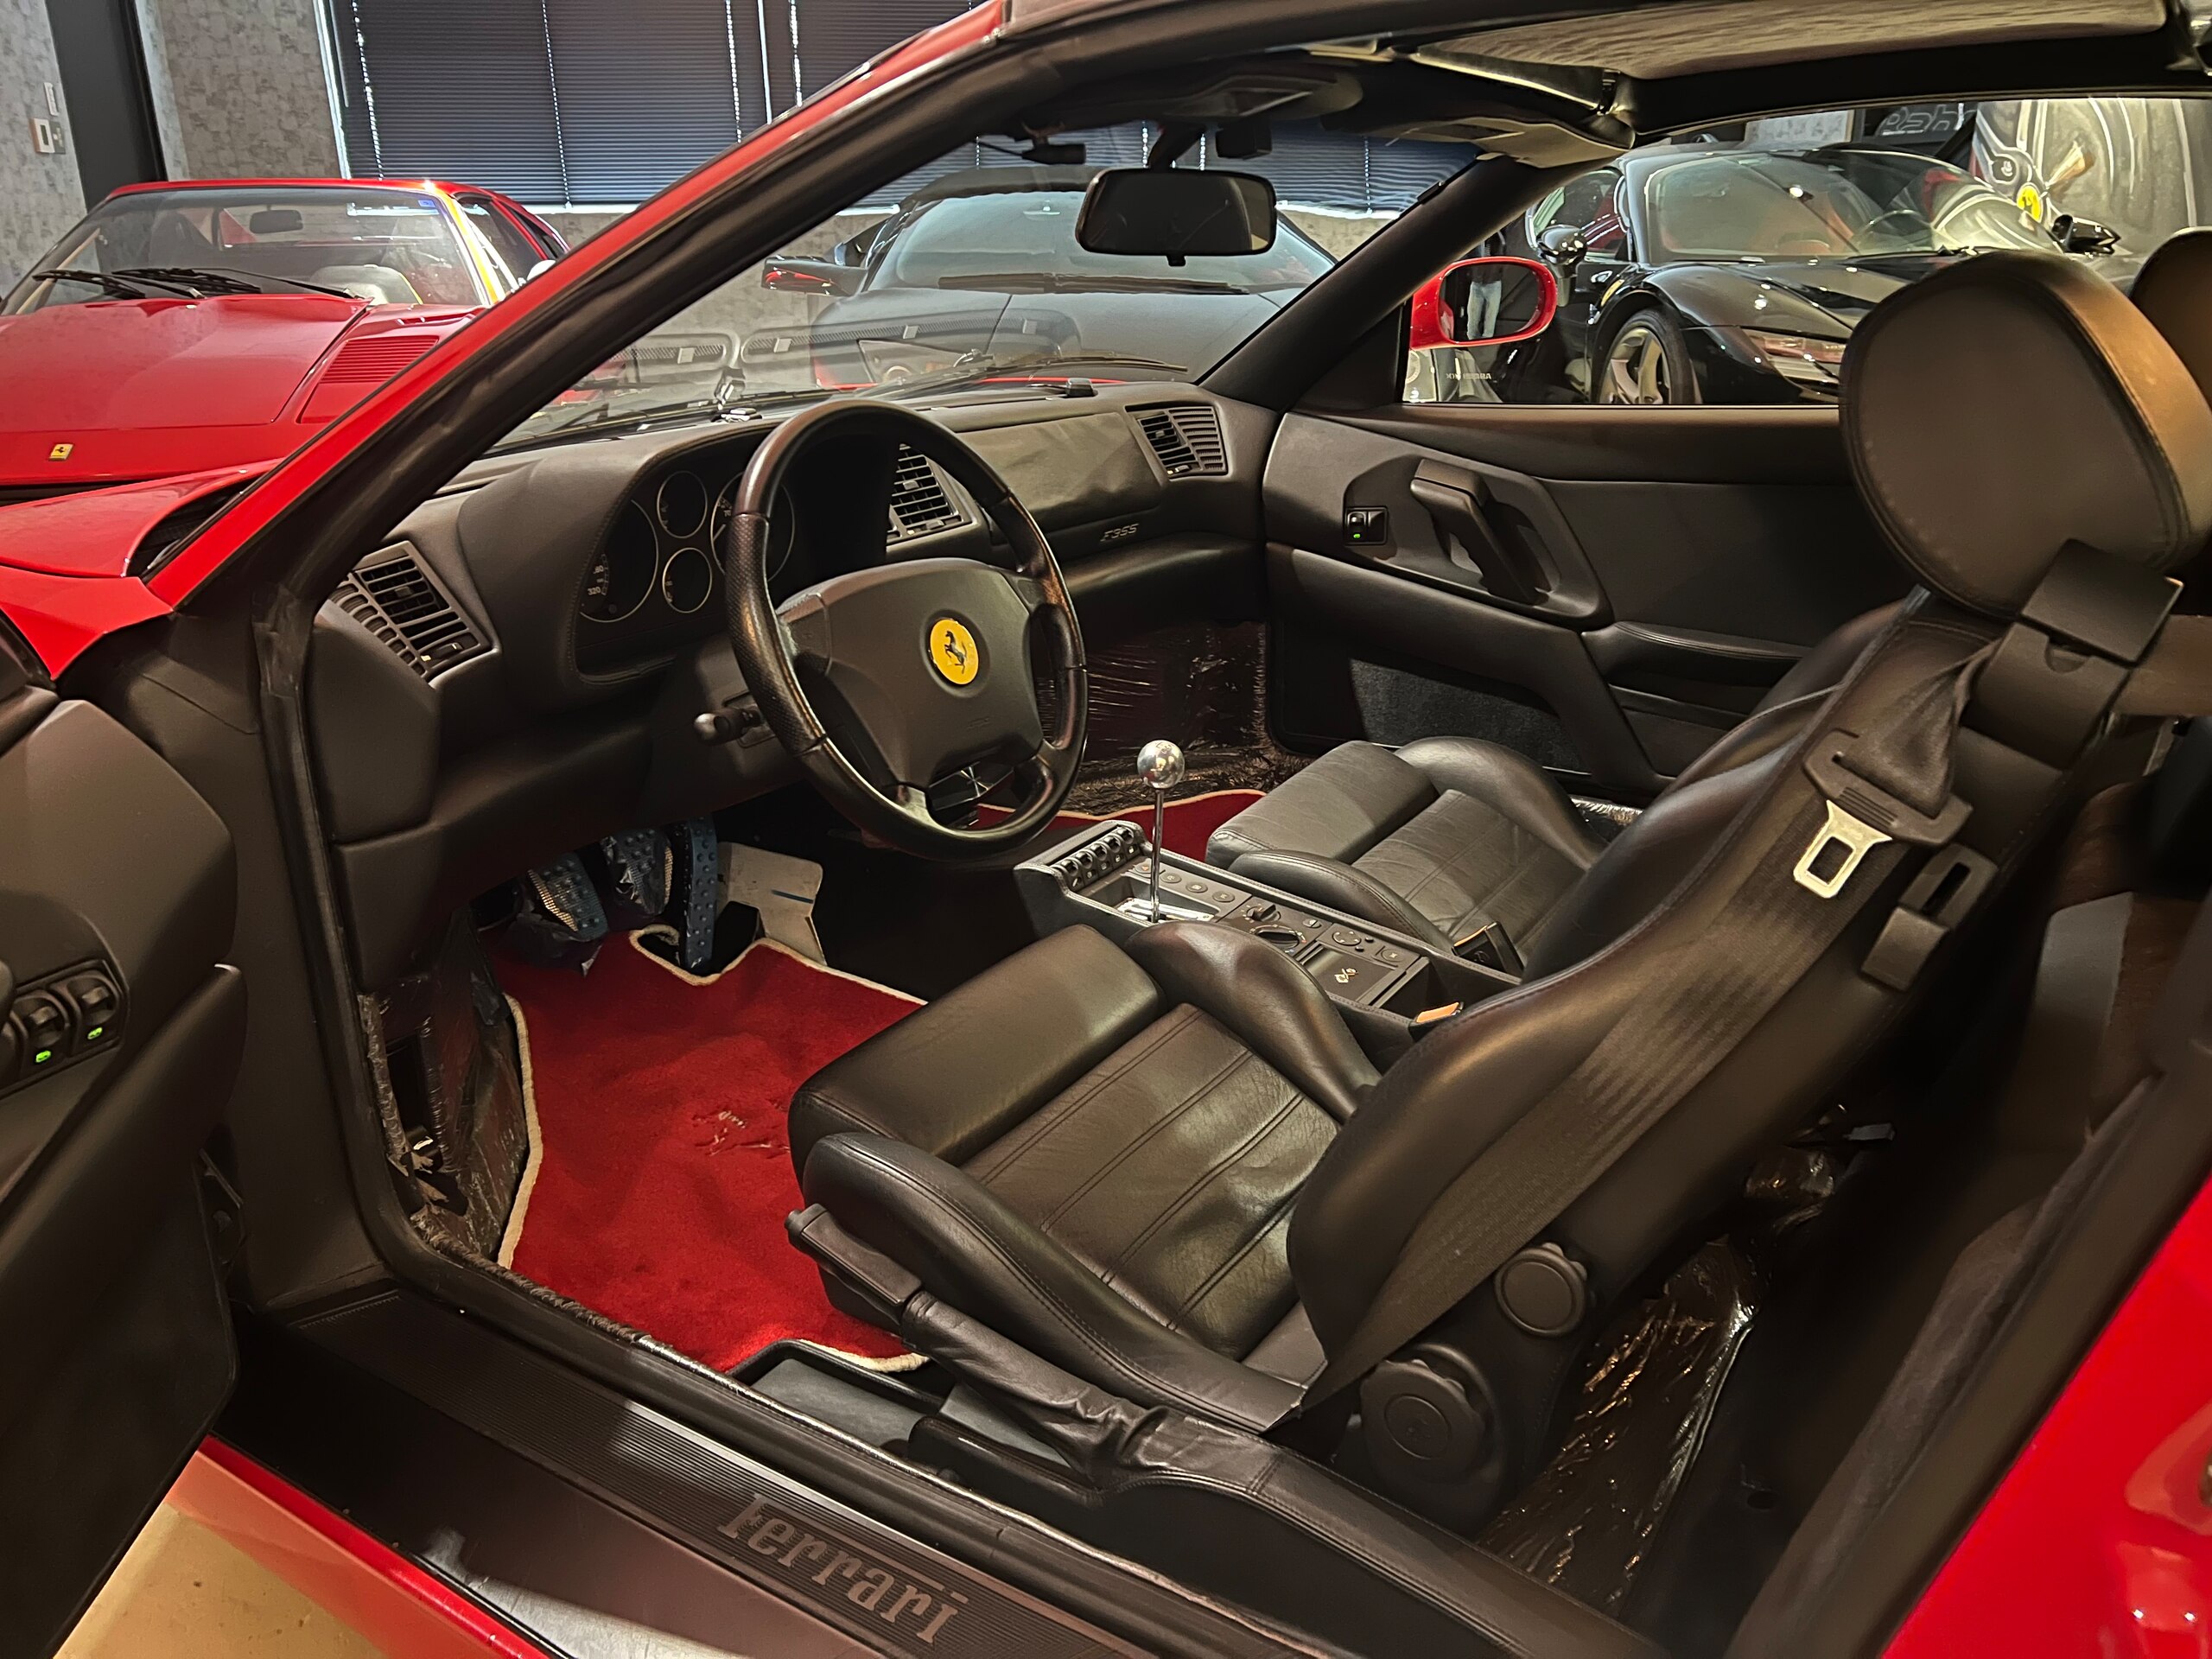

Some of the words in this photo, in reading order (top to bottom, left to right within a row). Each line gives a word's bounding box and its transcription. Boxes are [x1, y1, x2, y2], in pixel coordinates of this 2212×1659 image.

[1100, 523, 1139, 542] F355
[587, 586, 601, 595] 320
[717, 1493, 969, 1643] Ferrari
